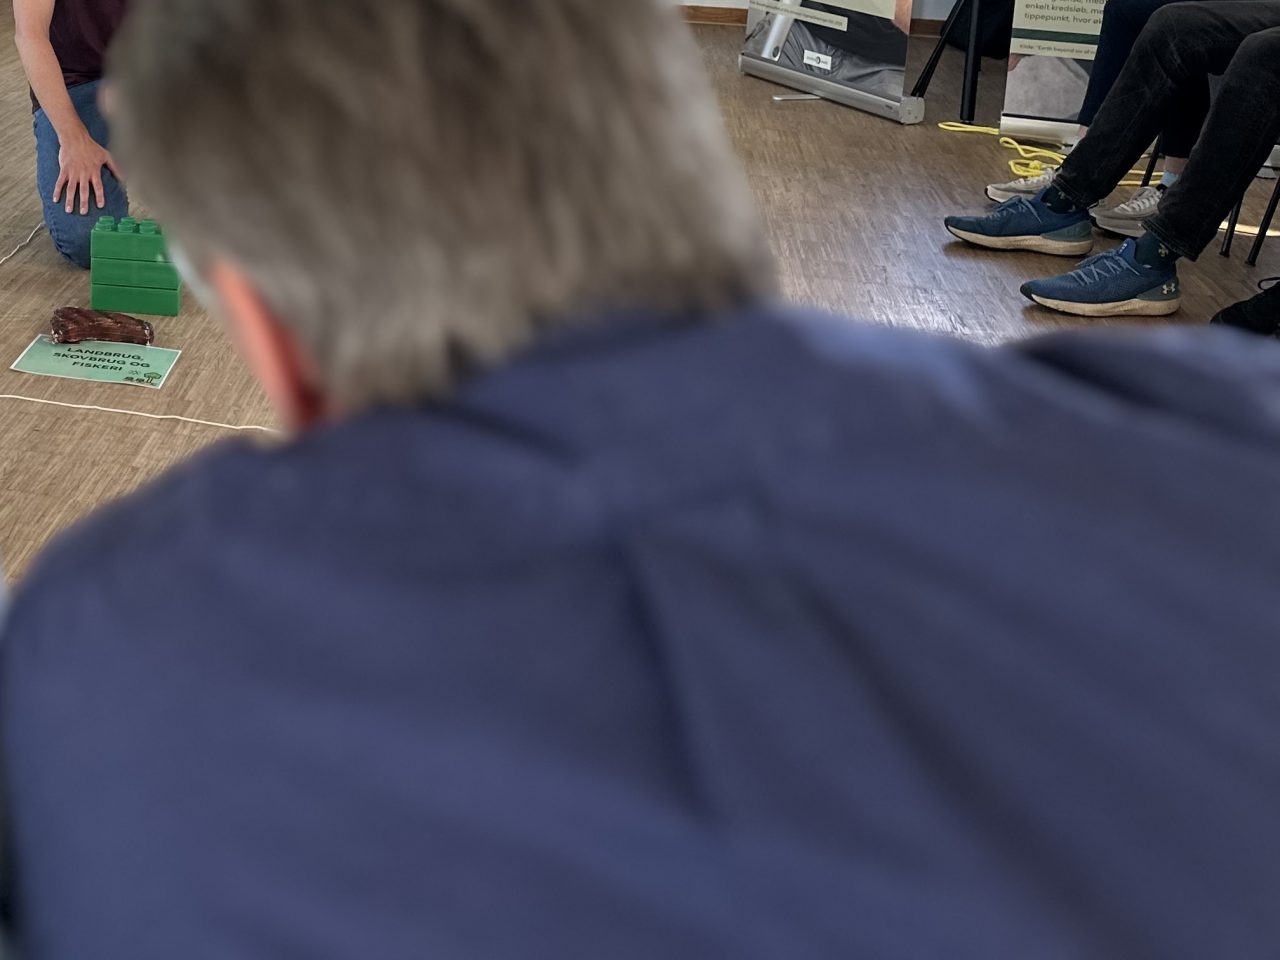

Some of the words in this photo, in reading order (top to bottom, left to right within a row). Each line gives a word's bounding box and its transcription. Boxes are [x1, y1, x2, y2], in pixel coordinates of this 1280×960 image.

[1025, 3, 1050, 11] enkelt
[1072, 15, 1091, 24] hvor
[52, 352, 127, 365] SKOVBRUG
[67, 347, 145, 362] LANDBRUG,
[72, 361, 123, 372] FISKERI
